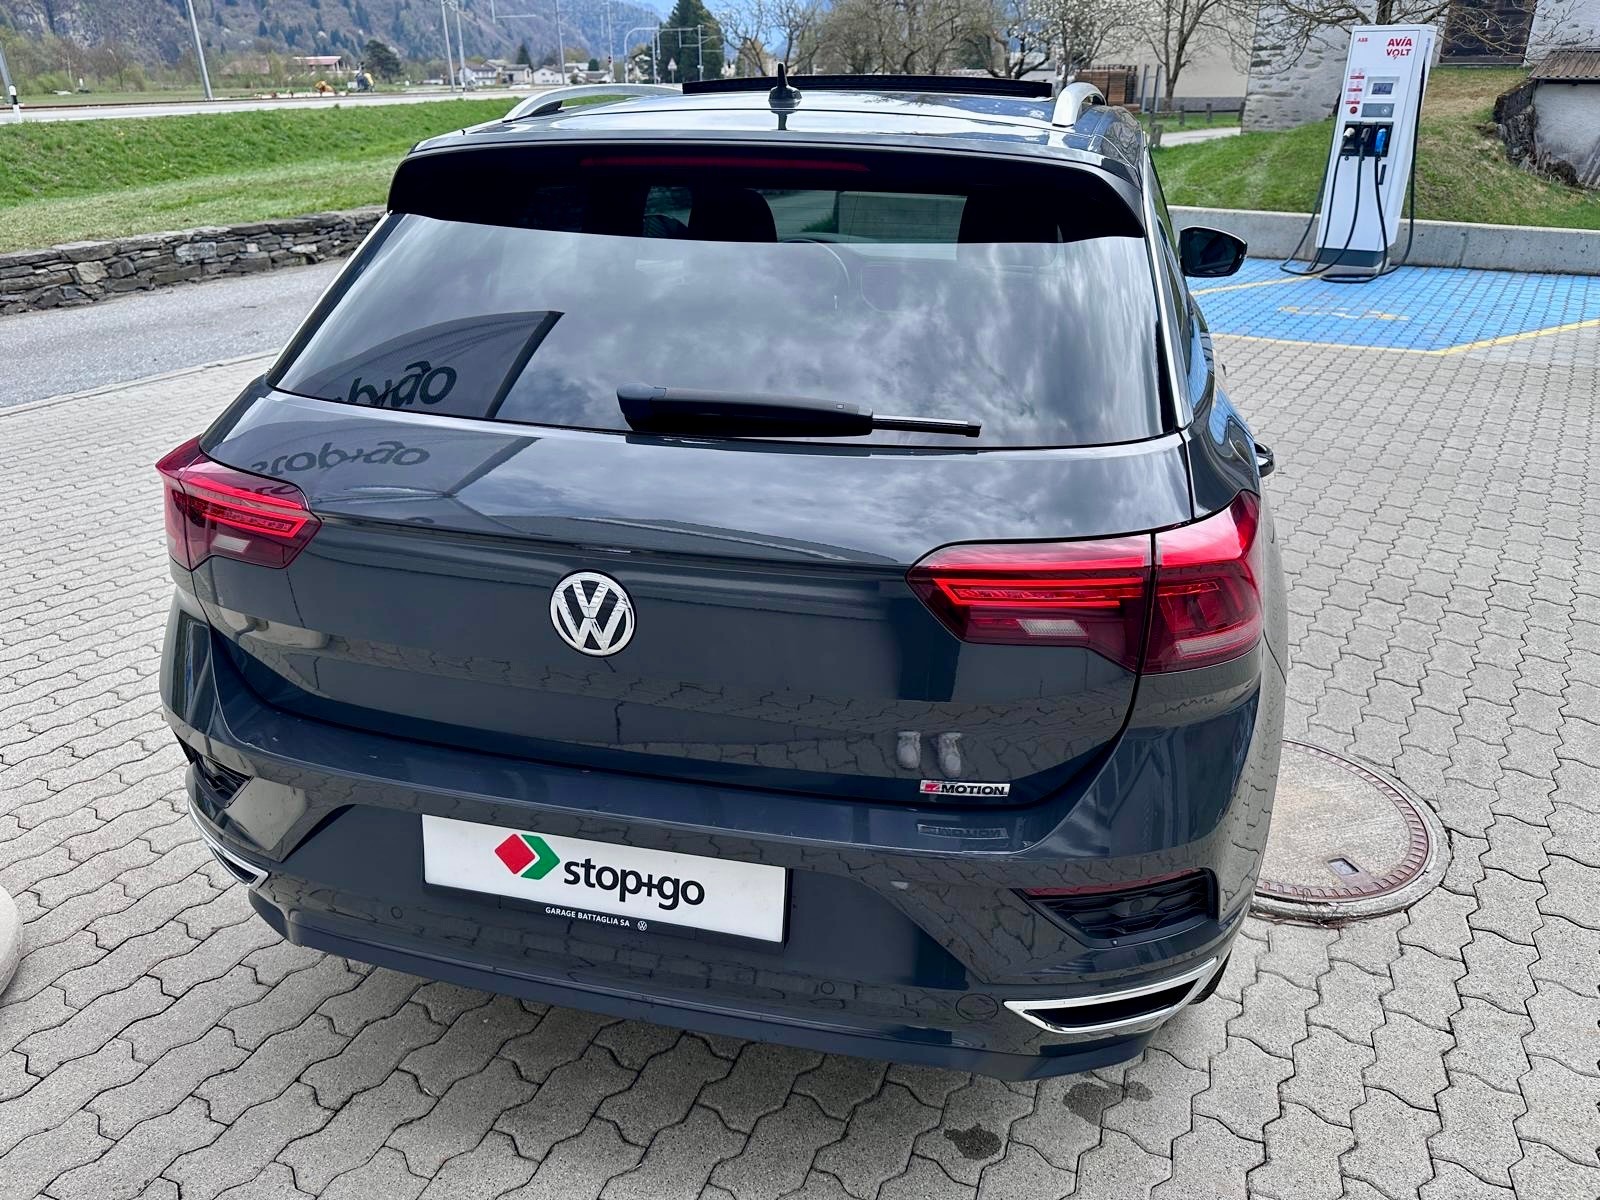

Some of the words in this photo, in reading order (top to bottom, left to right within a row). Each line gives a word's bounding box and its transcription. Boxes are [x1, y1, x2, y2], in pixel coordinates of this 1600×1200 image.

[1386, 48, 1412, 60] VOLT
[551, 572, 635, 656] VW
[563, 858, 705, 910] stop+go
[545, 907, 576, 918] GARAGE
[577, 912, 619, 925] BATTAGLIA
[620, 919, 630, 927] SA
